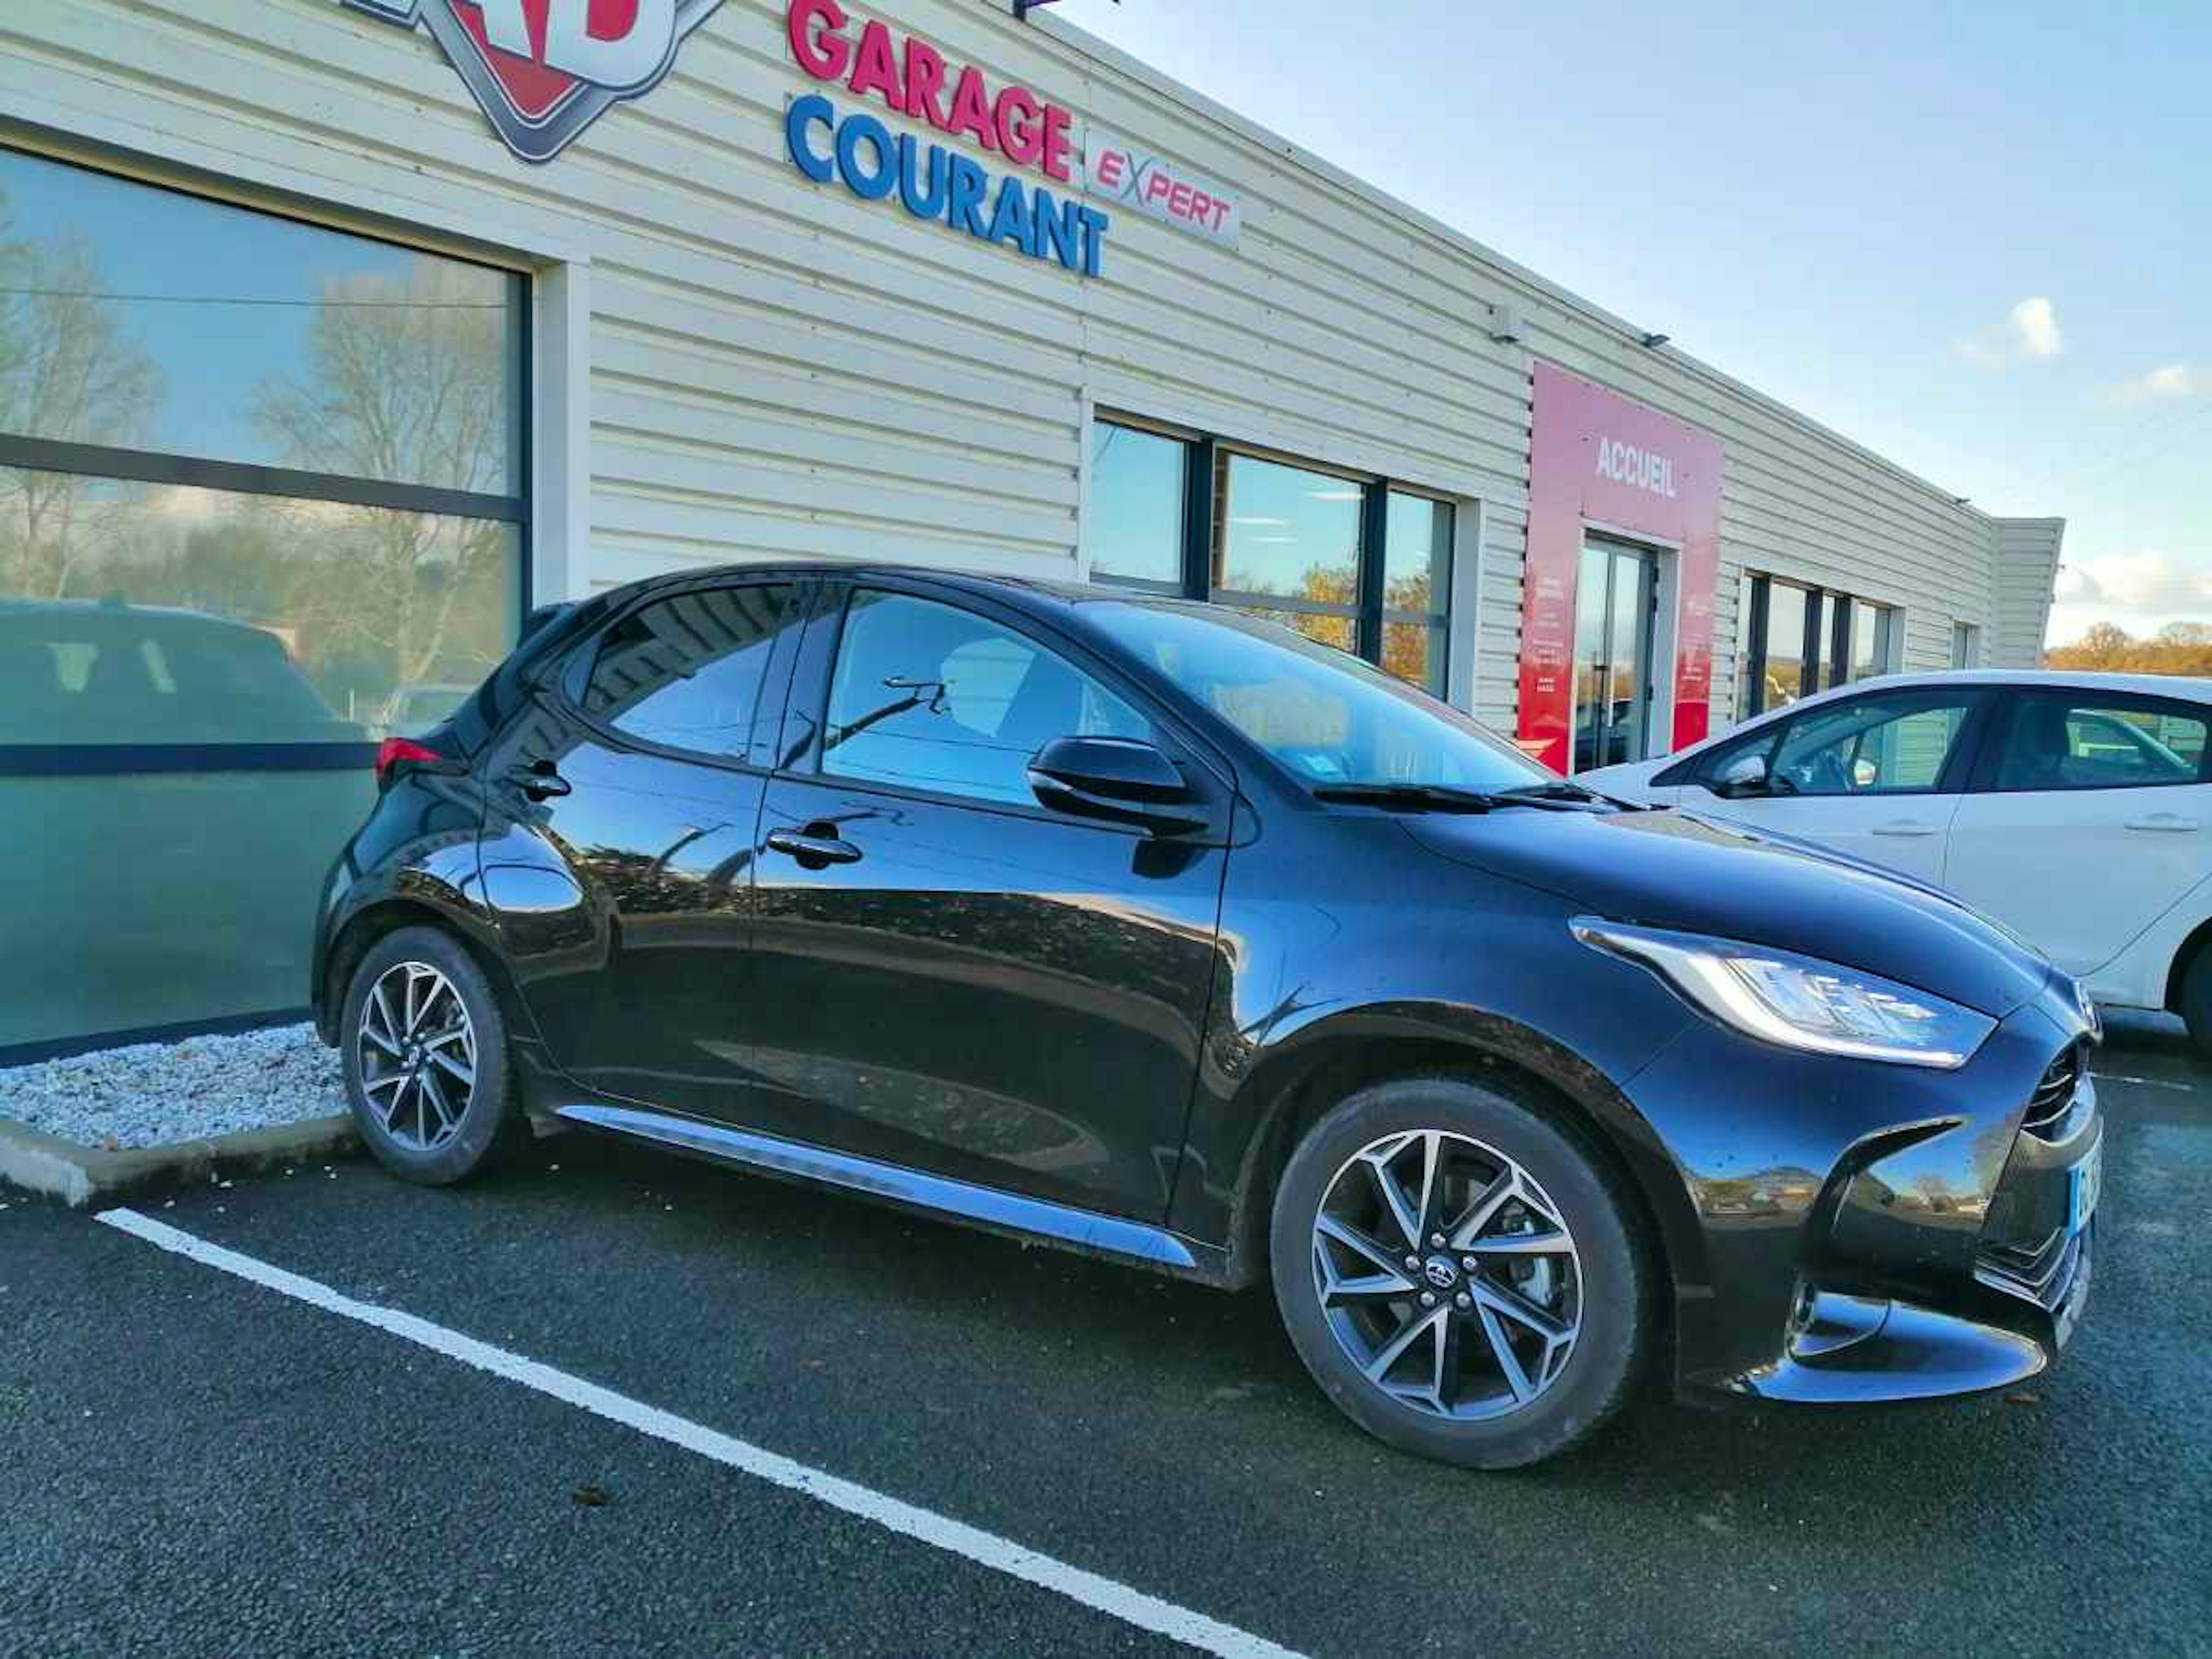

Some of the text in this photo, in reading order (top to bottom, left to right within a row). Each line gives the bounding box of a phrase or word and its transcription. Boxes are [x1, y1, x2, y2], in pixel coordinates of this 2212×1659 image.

[788, 0, 1073, 182] GARAGE
[787, 94, 1109, 278] COURANT
[1097, 150, 1230, 232] EXPERT
[1596, 437, 1677, 498] ACCUEIL
